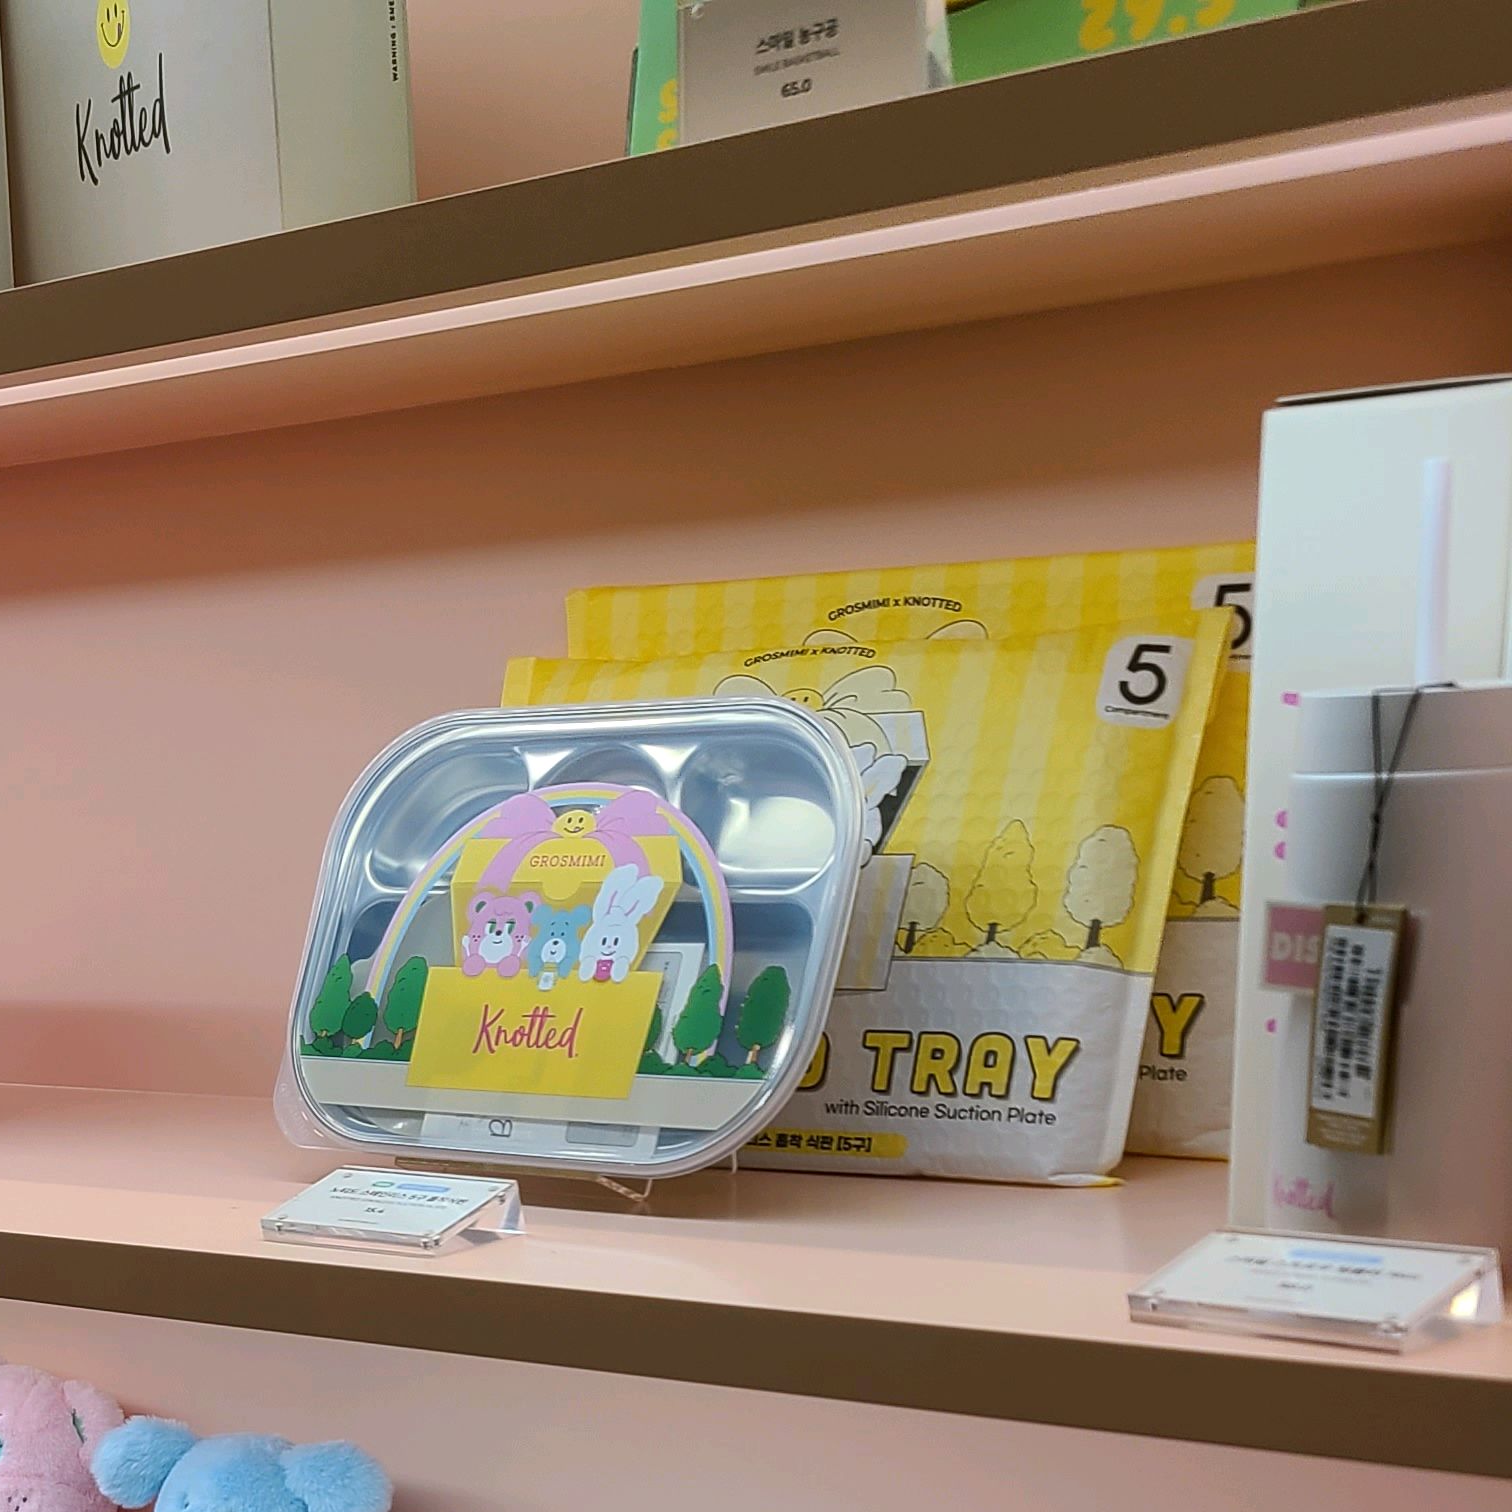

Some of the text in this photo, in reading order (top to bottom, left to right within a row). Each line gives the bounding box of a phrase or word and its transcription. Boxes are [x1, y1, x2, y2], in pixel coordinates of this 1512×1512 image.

[76, 53, 171, 186] Knotted
[827, 597, 891, 622] GROSMIMI
[903, 596, 963, 613] KNOTTED
[820, 645, 877, 660] KNOTTED
[1118, 643, 1172, 706] 5
[529, 854, 606, 868] GROSMIMI
[471, 1003, 584, 1059] Knotted
[862, 1028, 1081, 1100] TRAY
[1138, 1064, 1188, 1082] Plate
[824, 1098, 1057, 1127] with Silicone Suction Plate
[836, 1136, 873, 1153] [5구]
